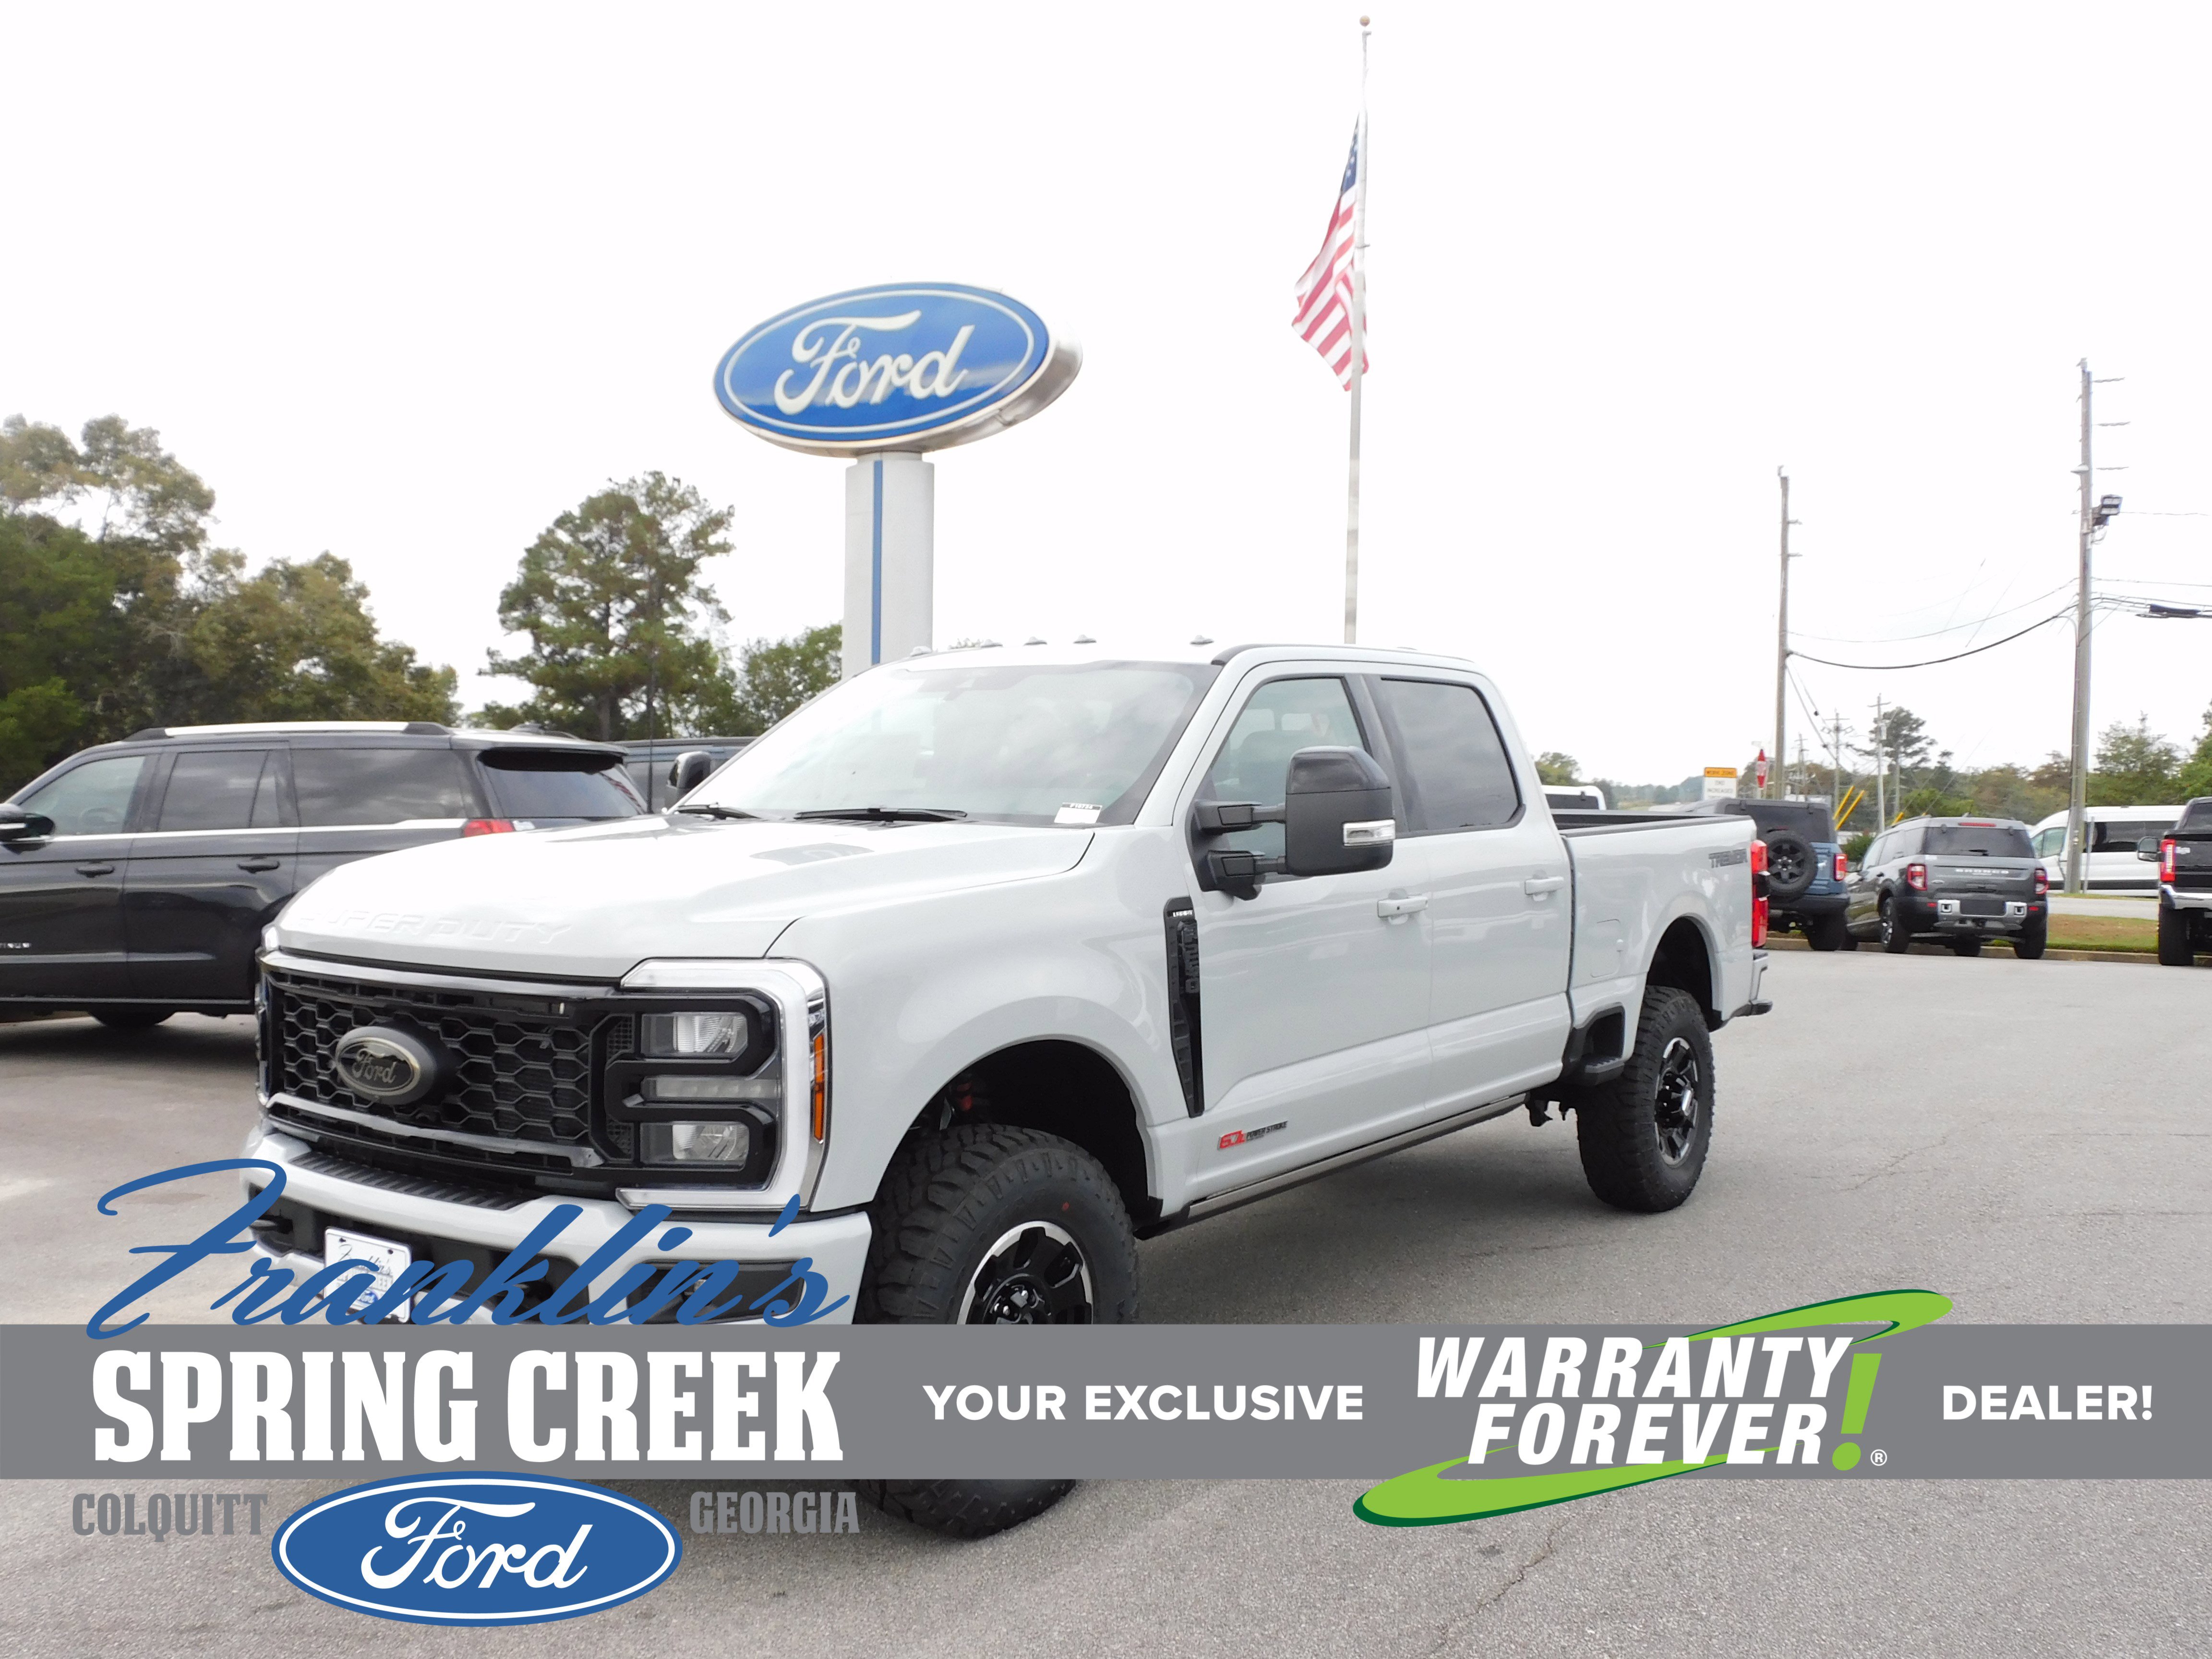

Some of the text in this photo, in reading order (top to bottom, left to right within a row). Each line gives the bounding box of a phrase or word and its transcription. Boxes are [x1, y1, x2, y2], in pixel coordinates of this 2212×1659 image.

[774, 309, 976, 415] Ford
[427, 917, 573, 944] DUTY
[351, 1048, 397, 1083] Ford
